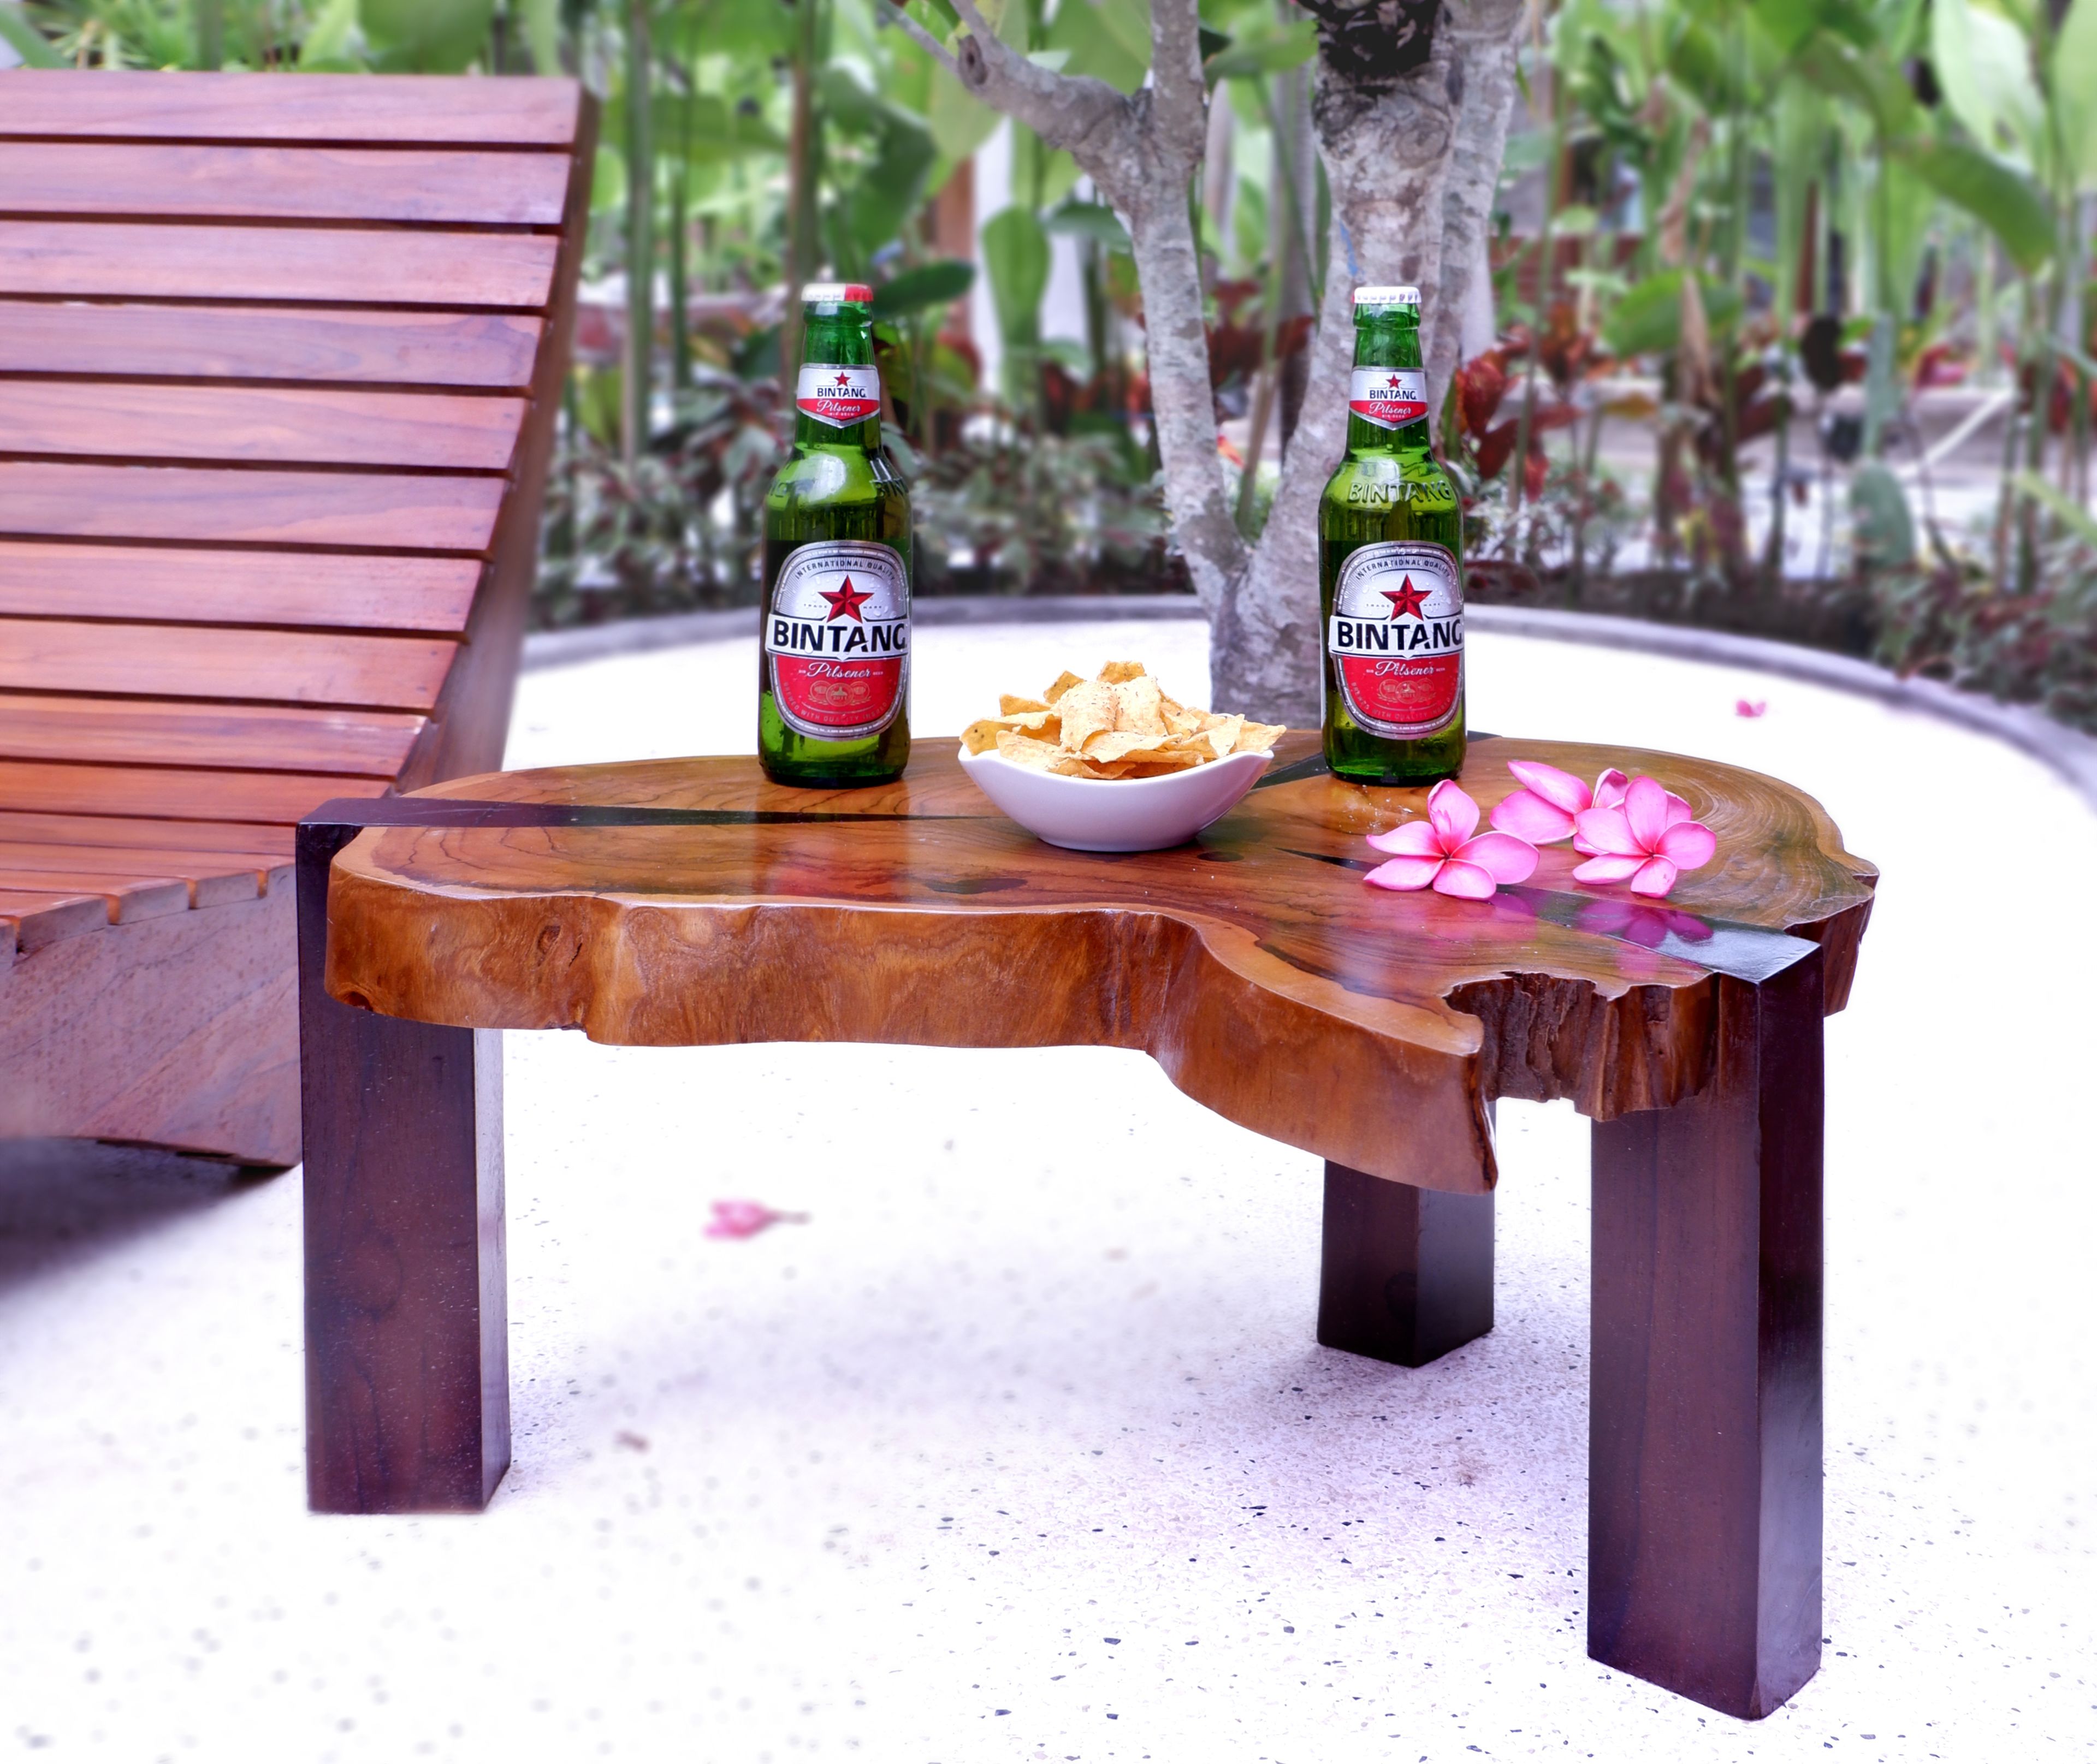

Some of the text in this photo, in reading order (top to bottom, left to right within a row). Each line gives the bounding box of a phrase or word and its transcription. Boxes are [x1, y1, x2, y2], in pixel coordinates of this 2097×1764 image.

[817, 388, 867, 397] BINTANG
[1369, 390, 1417, 400] BINTANG
[816, 400, 861, 412] Pilsener
[1369, 402, 1412, 414] Pilsener
[1347, 480, 1452, 503] BINTANG
[795, 560, 896, 580] INTERNATIONAL QUALITY
[1355, 559, 1450, 580] INTERNATIONAL QUALITY
[773, 619, 908, 653] BINTANG
[1337, 619, 1462, 650] BINTANG
[807, 662, 872, 678] Pilsener
[1375, 661, 1434, 676] Pilsener
[801, 710, 820, 720] WITH
